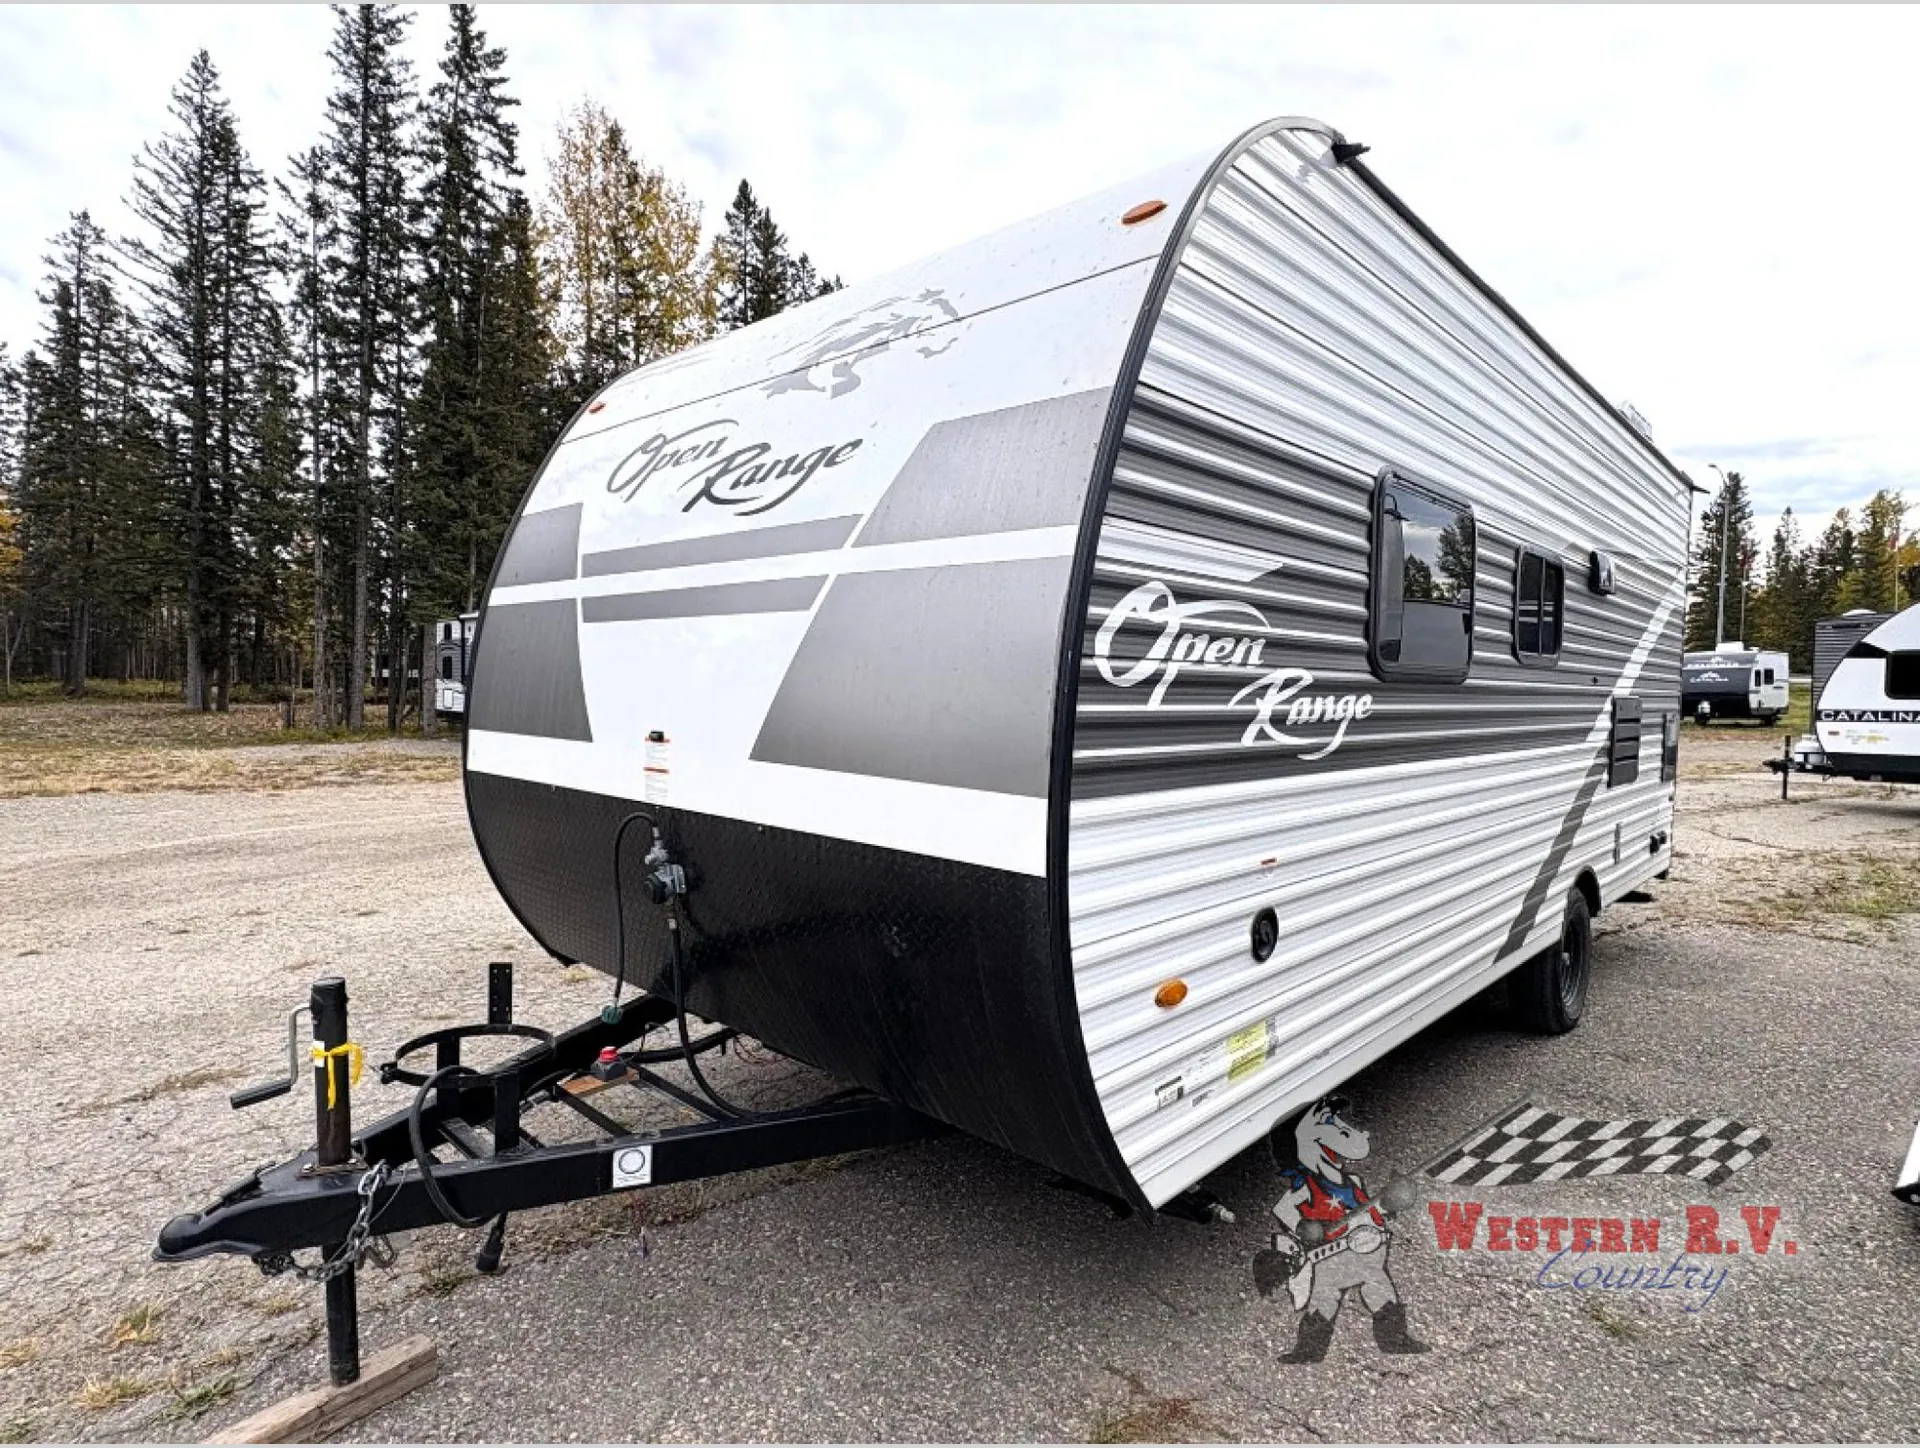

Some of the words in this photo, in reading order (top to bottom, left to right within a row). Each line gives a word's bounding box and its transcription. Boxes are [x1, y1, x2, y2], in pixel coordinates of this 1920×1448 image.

[606, 418, 740, 503] Open
[676, 438, 864, 517] Range
[1092, 580, 1271, 711] Open
[1226, 667, 1374, 761] Range
